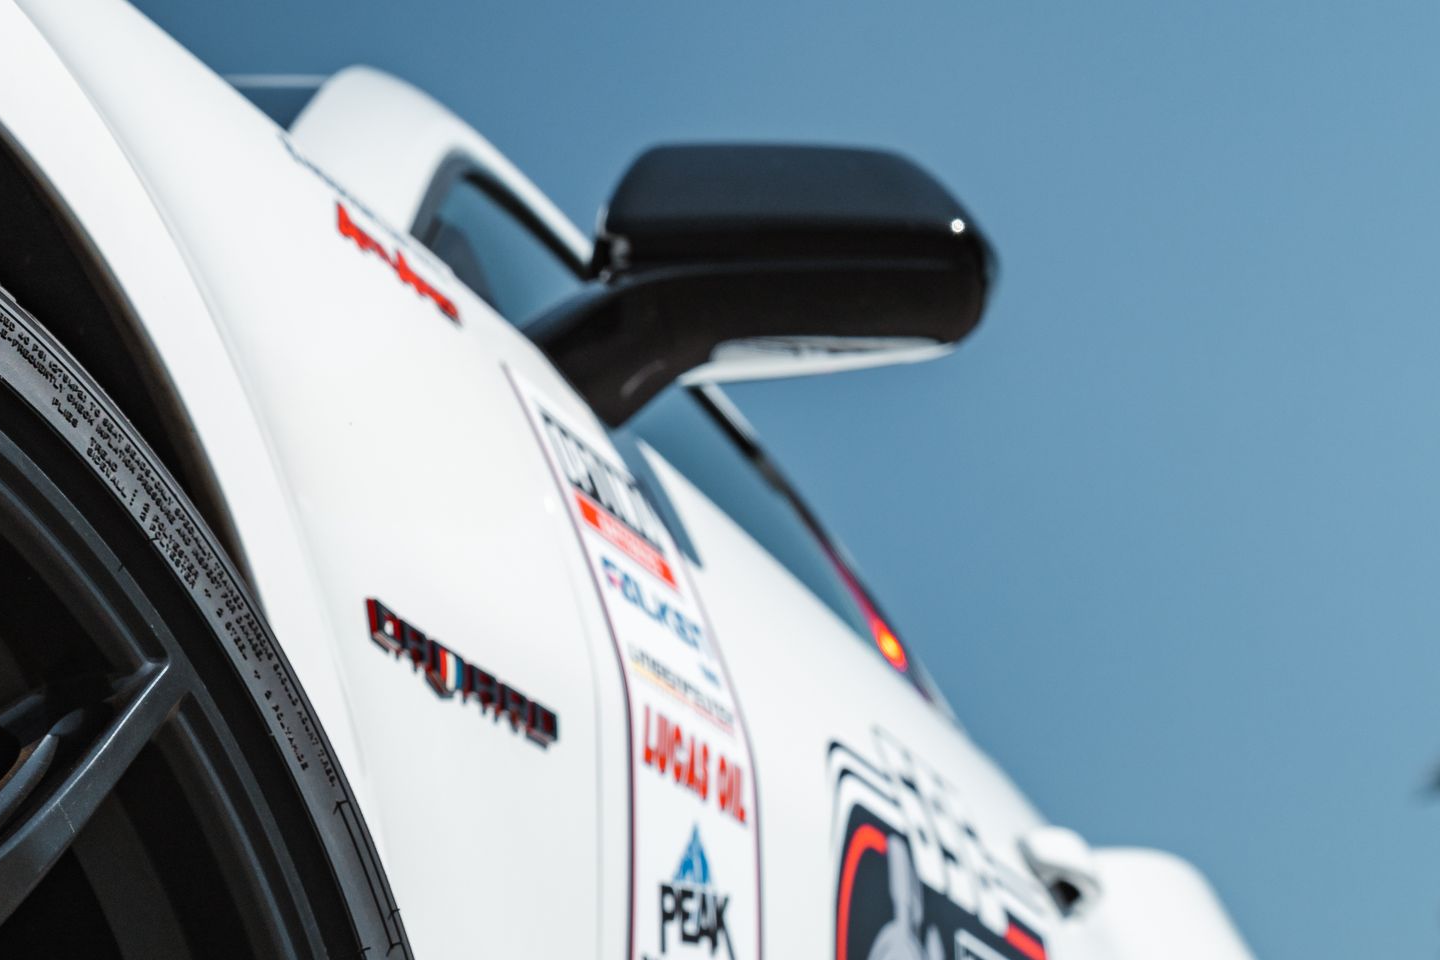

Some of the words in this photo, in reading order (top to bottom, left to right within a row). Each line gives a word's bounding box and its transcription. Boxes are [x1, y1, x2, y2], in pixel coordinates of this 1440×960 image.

[17, 333, 29, 345] 40
[31, 343, 46, 362] PSI
[89, 401, 100, 418] TO
[101, 417, 123, 443] SEAT
[174, 507, 212, 560] SPECIALLY
[213, 562, 244, 610] TRAINED
[243, 612, 273, 660] PERSONS
[272, 663, 298, 706] SHOULD
[296, 711, 319, 745] MOUNT
[51, 397, 78, 428] PLIES
[90, 436, 117, 472] TREAD
[152, 514, 201, 580] POLYESTER
[224, 621, 247, 660] STEEL
[66, 393, 94, 426] CHECK
[95, 424, 135, 474] INFLATION
[136, 473, 176, 525] PRESSURE
[175, 528, 191, 546] AND
[191, 550, 222, 589] INSPECT
[220, 592, 236, 614] FOR
[86, 447, 127, 499] SIDEWALL
[643, 704, 709, 801] LUCAS
